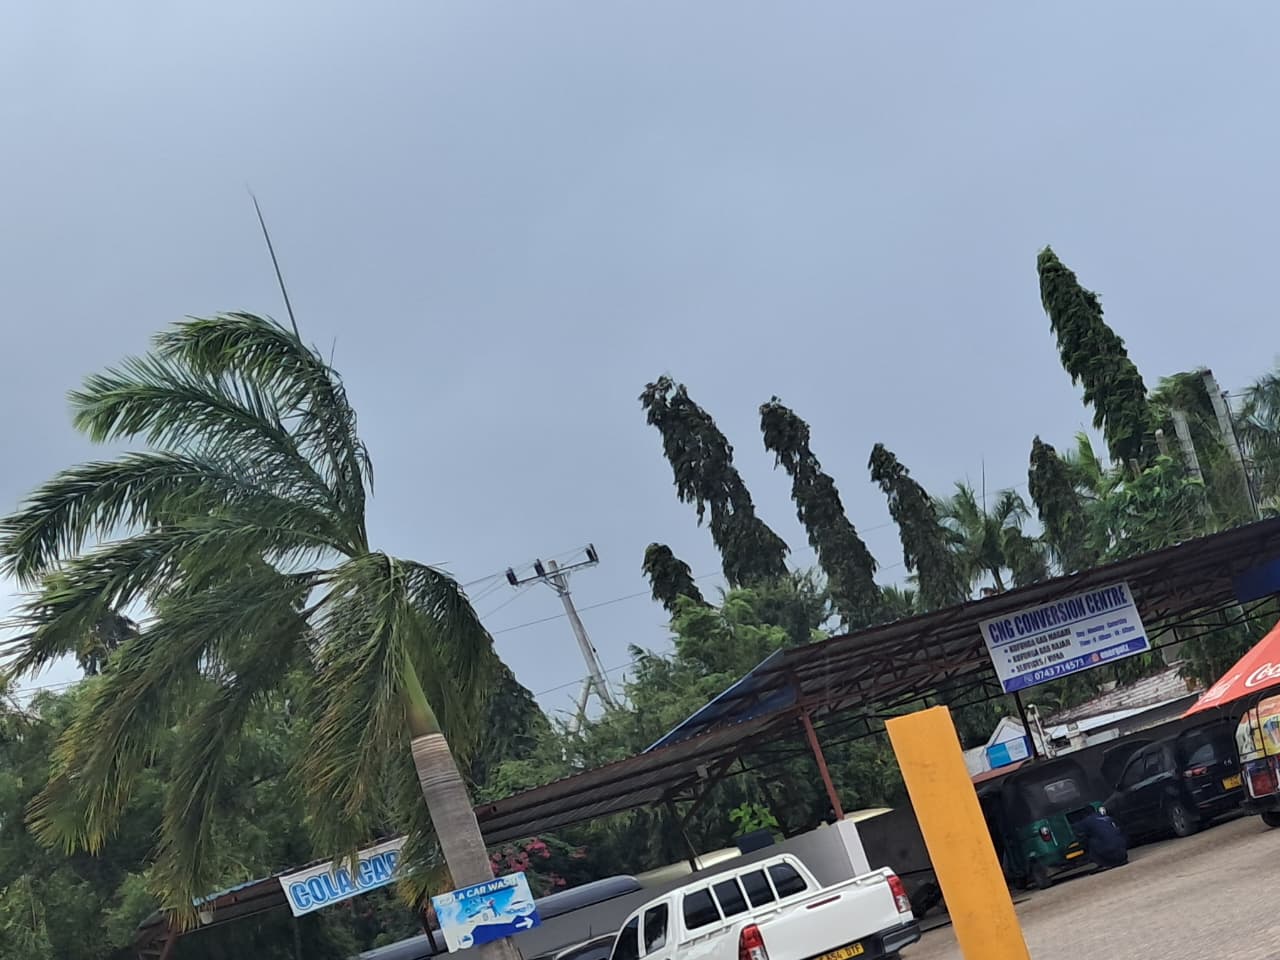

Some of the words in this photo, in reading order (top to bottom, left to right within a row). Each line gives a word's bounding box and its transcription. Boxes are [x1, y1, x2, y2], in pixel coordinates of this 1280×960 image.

[988, 619, 1015, 643] CNG
[1015, 597, 1086, 635] CONVERSION
[1085, 586, 1128, 613] CENTRE
[1034, 667, 1055, 680] 0743
[289, 866, 358, 910] COLA
[466, 886, 487, 898] CAR
